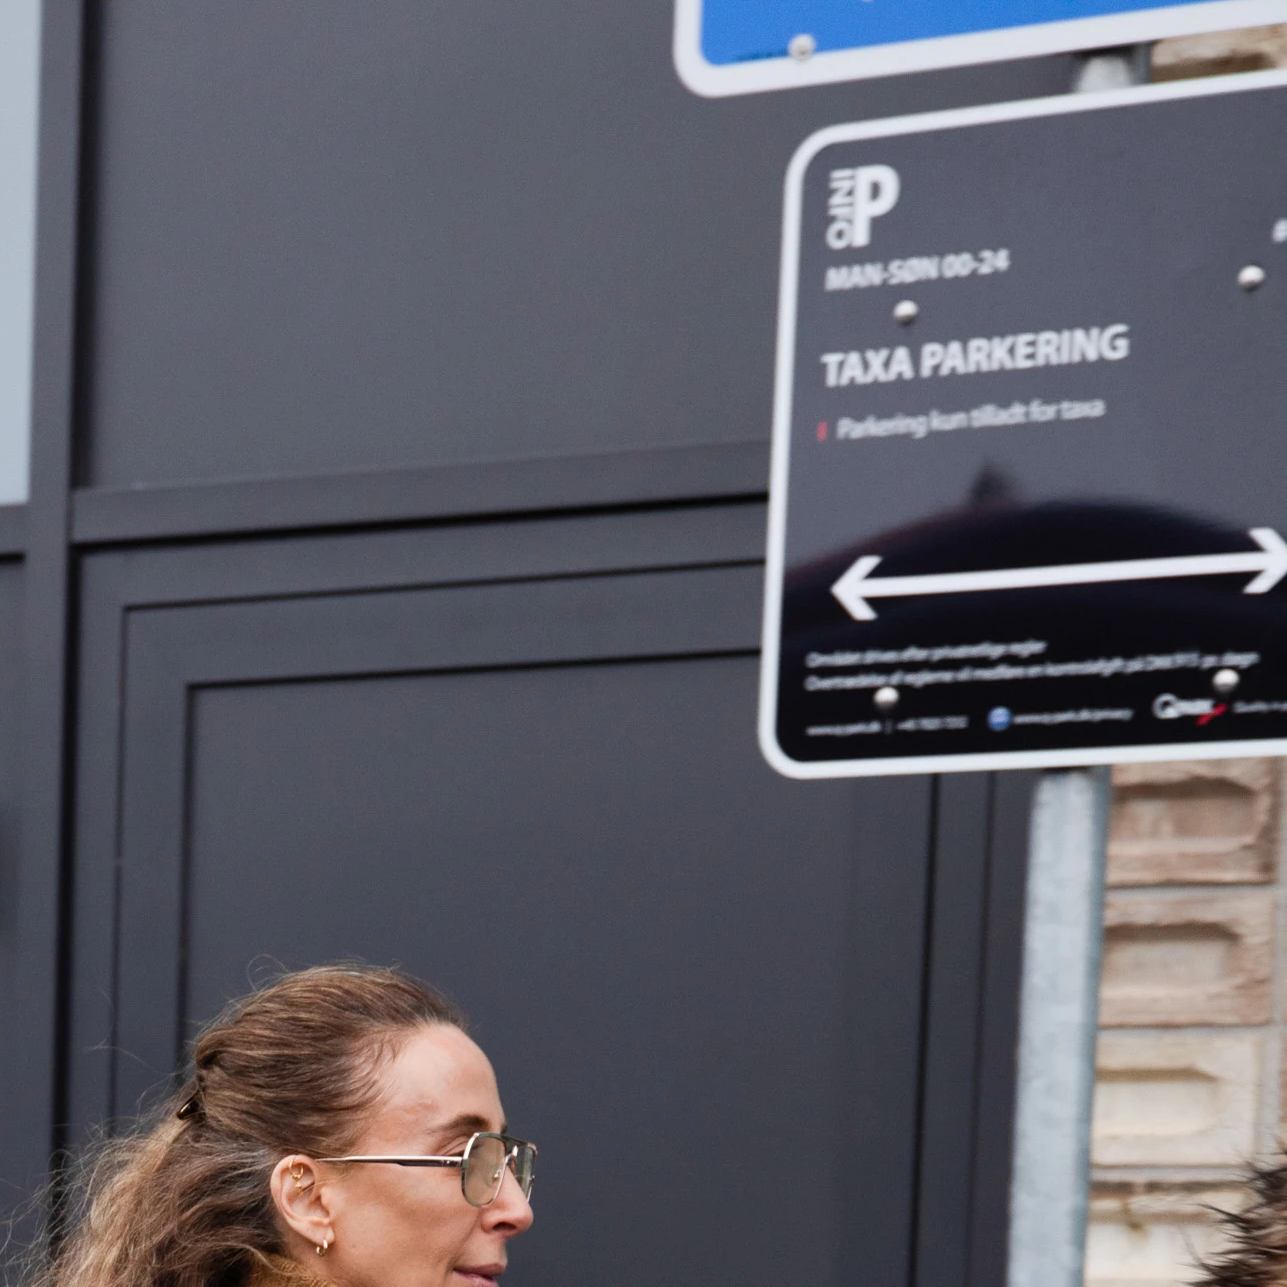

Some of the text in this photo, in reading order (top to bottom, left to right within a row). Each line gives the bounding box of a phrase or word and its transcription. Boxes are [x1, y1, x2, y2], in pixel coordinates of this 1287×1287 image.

[851, 164, 900, 247] P
[820, 323, 1129, 387] TAXA PARKERING
